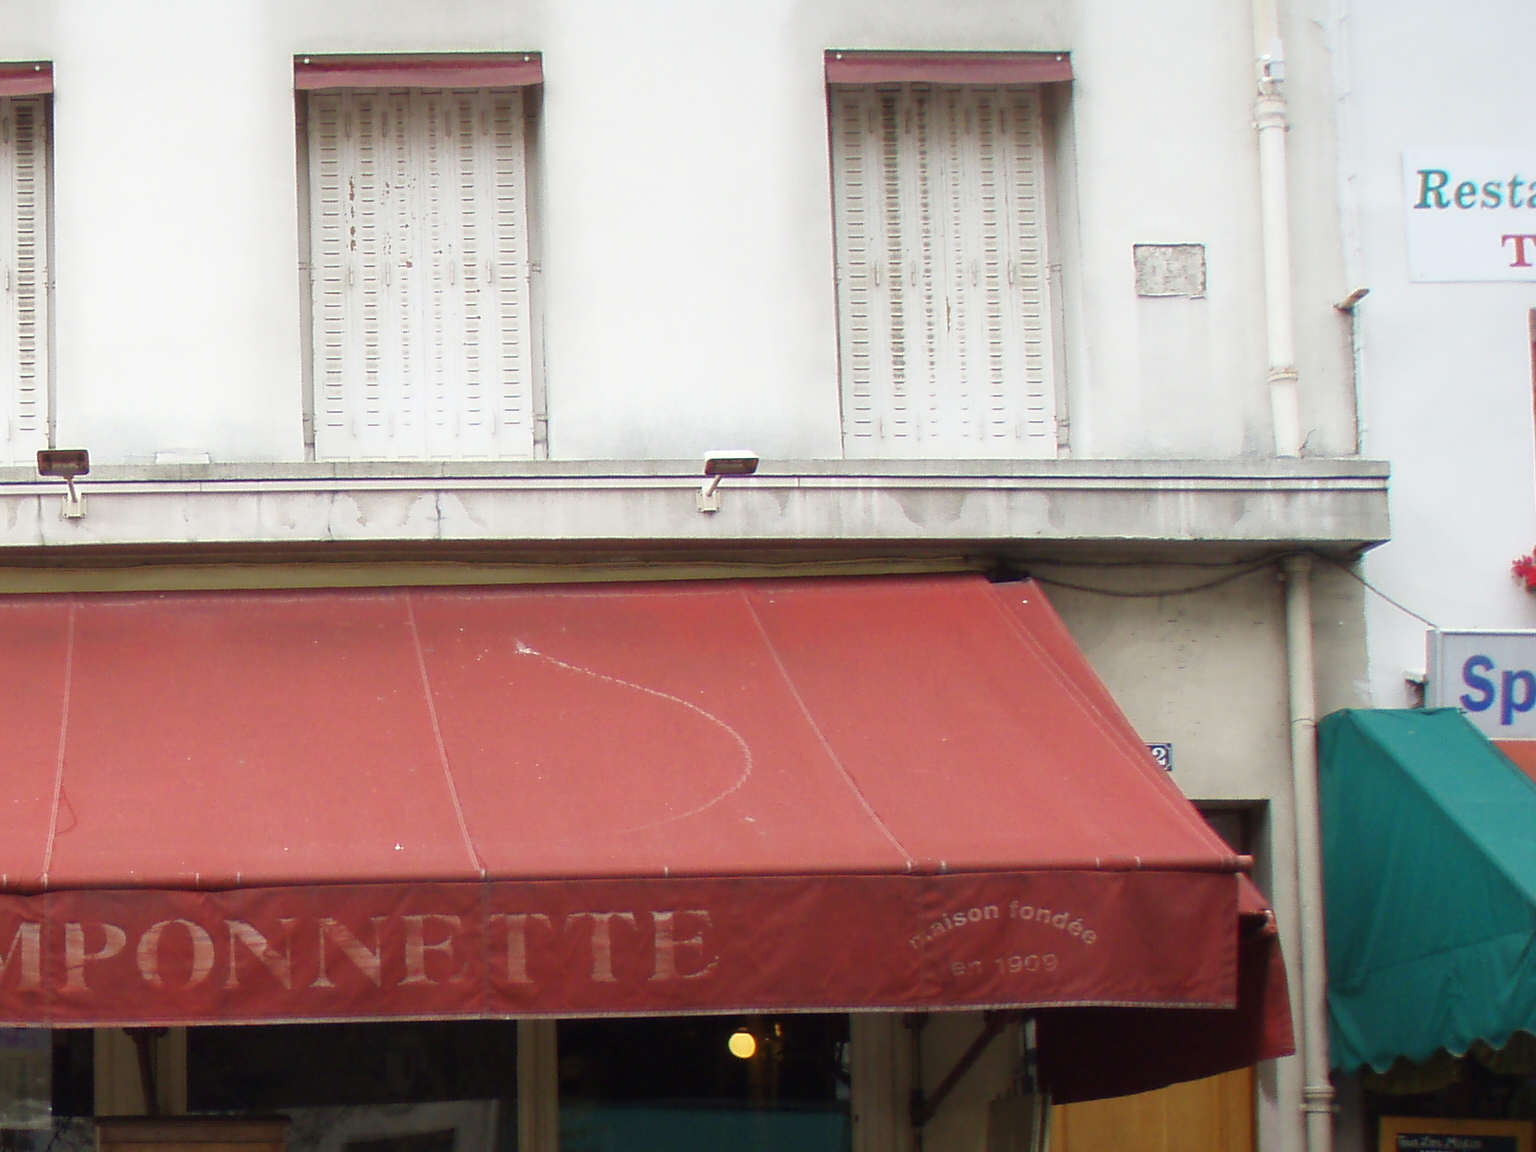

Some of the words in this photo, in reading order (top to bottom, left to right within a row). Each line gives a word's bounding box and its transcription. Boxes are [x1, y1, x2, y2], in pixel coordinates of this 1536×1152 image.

[1460, 654, 1536, 726] Sp
[1009, 899, 1097, 944] fondée
[995, 953, 1058, 974] 1909
